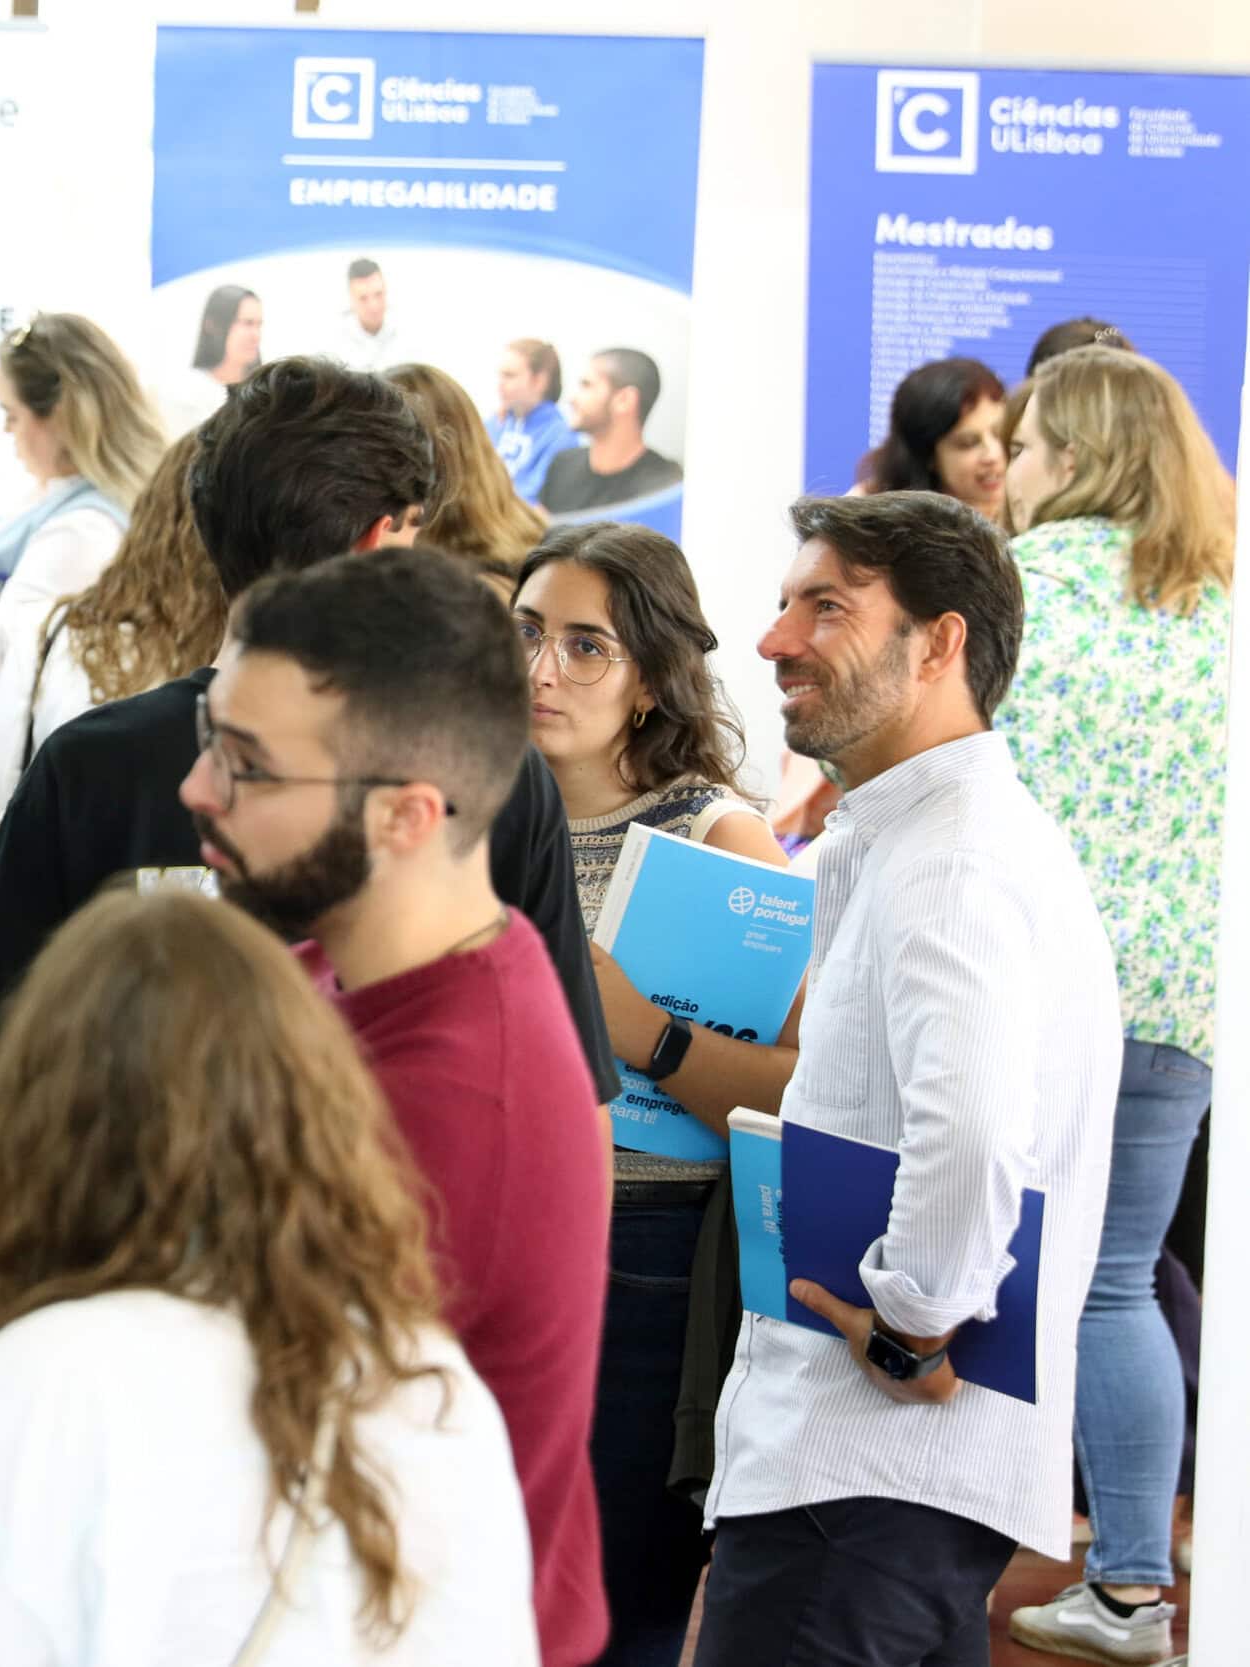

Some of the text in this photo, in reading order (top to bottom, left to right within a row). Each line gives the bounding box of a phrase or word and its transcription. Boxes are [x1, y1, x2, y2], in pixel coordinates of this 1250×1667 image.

[381, 77, 482, 104] Ciências
[989, 96, 1121, 129] Ciências
[990, 126, 1103, 156] ULisboa
[289, 177, 559, 212] EMPREGABILIDADE
[875, 212, 1054, 251] Mestrados
[753, 907, 810, 926] portugal
[759, 892, 798, 912] talent
[650, 992, 699, 1013] edição
[758, 1184, 773, 1217] para
